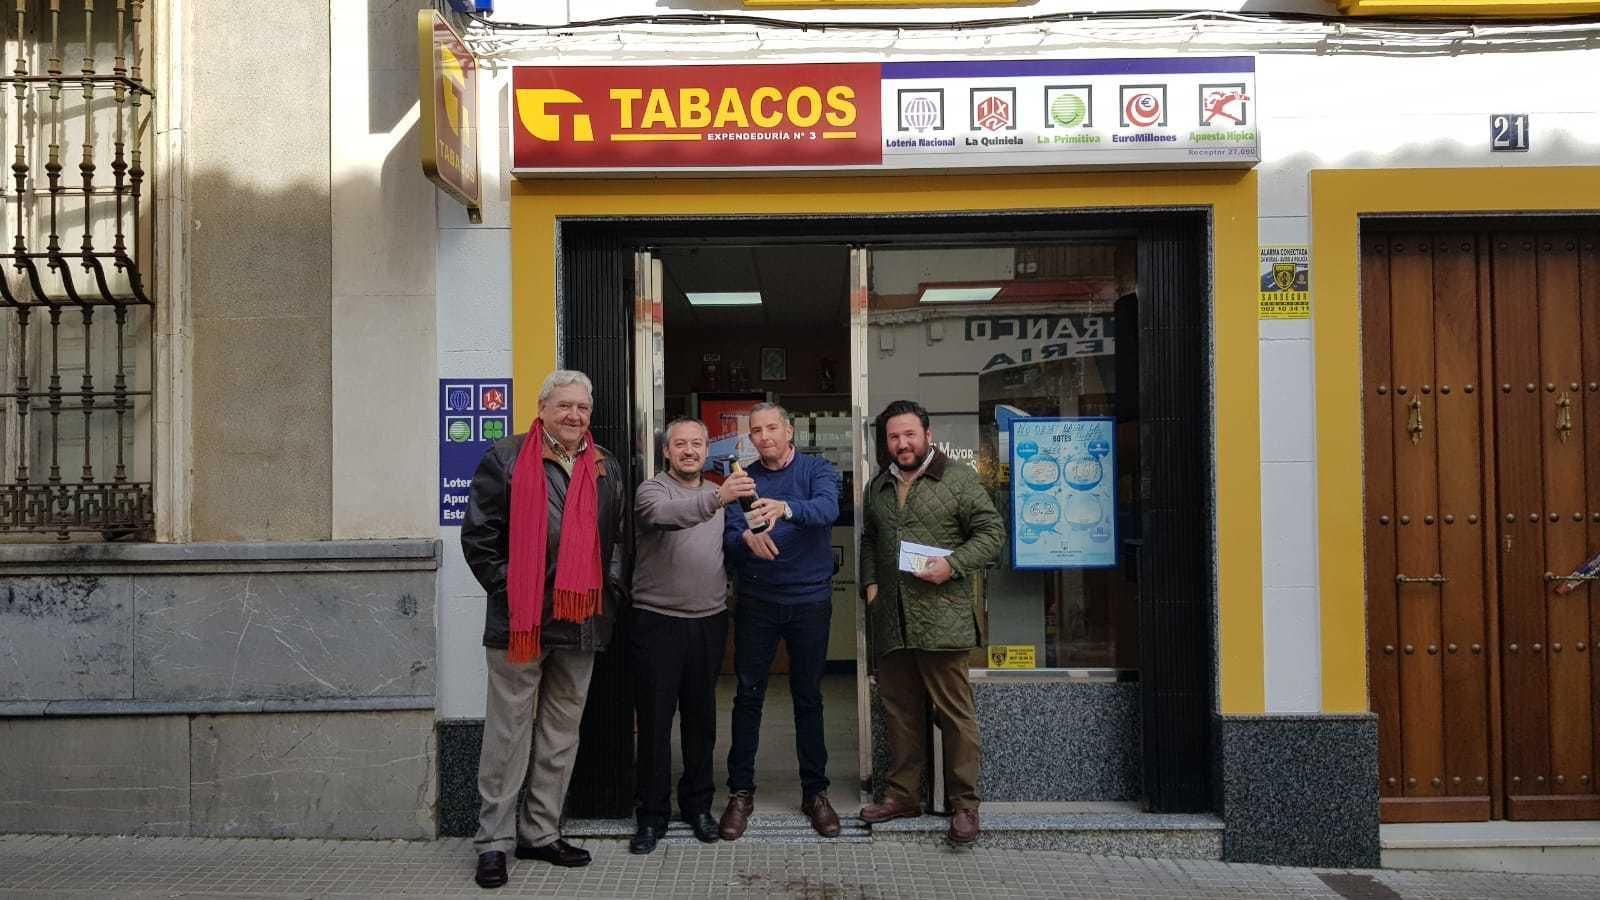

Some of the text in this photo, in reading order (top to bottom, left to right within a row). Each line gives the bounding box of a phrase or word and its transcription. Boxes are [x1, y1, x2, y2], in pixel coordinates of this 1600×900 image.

[609, 85, 858, 129] TABACOS
[707, 131, 791, 141] EXPENDEDURÍA
[809, 131, 817, 140] 3
[1493, 116, 1526, 147] 21
[918, 136, 955, 147] Nacional
[965, 135, 1024, 147] La Quiniela
[1036, 133, 1102, 144] La Primitiva
[1112, 132, 1177, 143] EuroMillones
[1189, 131, 1226, 144] Apuesta
[1188, 149, 1225, 157] Receptor
[439, 139, 475, 183] TABACOS
[1260, 248, 1308, 256] ALARMA CONECTADA
[443, 477, 472, 488] Loter
[443, 509, 465, 520] Esta
